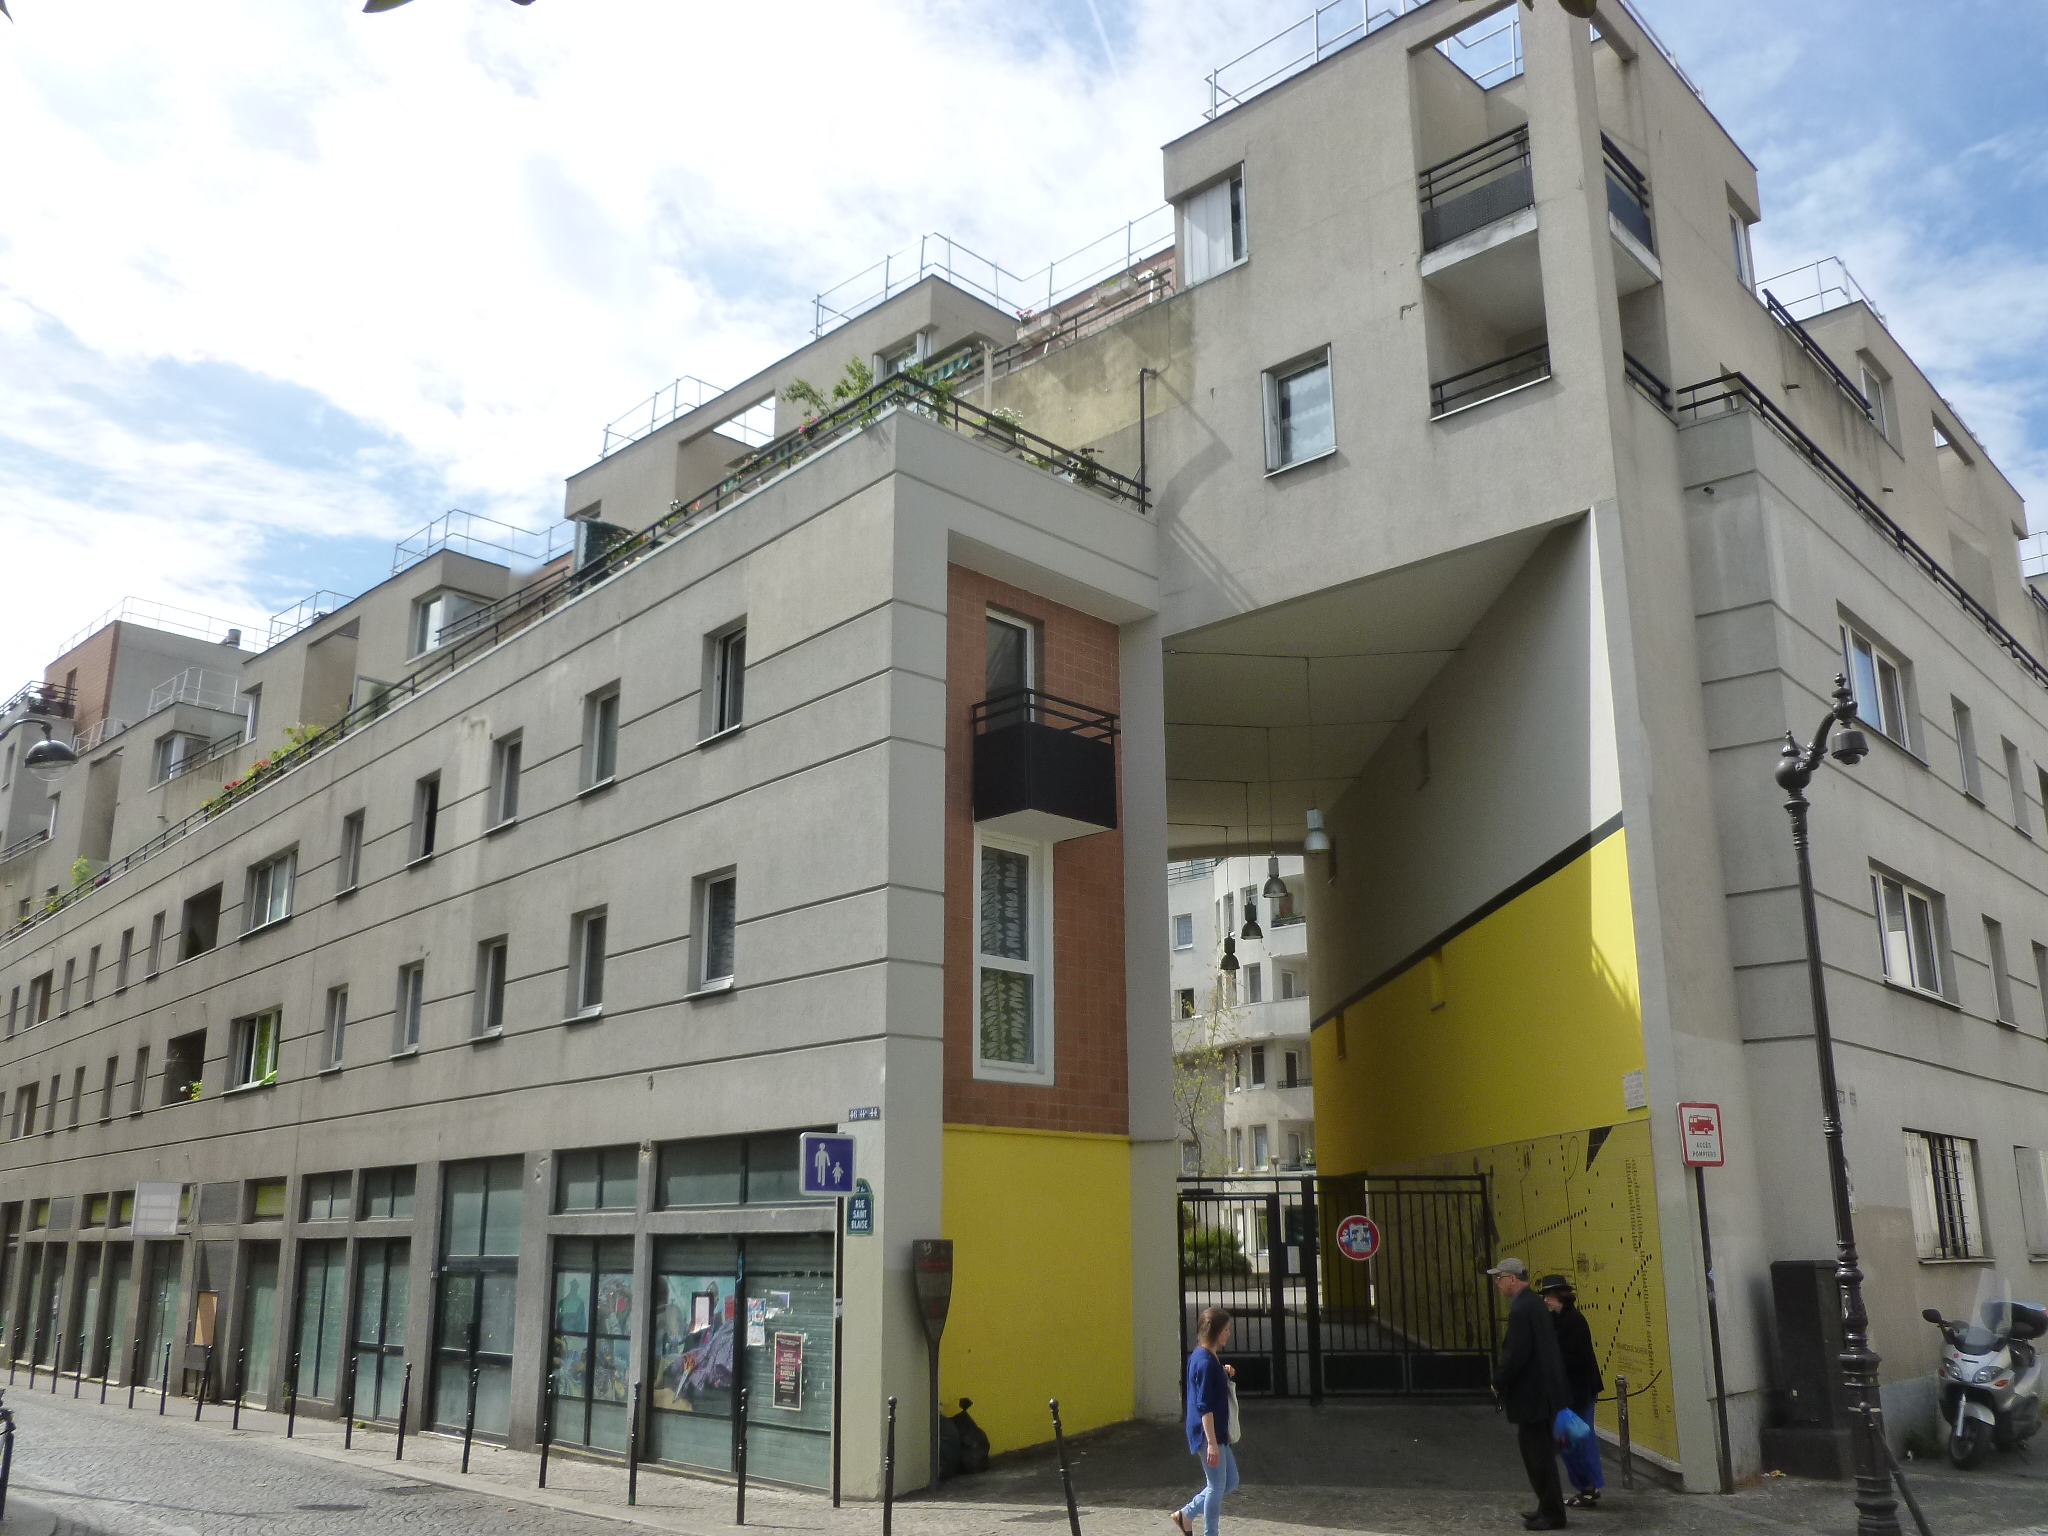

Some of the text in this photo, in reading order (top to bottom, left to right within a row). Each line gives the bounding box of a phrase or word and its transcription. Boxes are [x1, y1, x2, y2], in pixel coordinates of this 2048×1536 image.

[1696, 1141, 1712, 1149] ACCÈS
[1692, 1150, 1717, 1158] POMPIERS
[855, 1199, 865, 1209] RUE
[853, 1210, 867, 1219] SAINT
[851, 1220, 868, 1229] BLAISE
